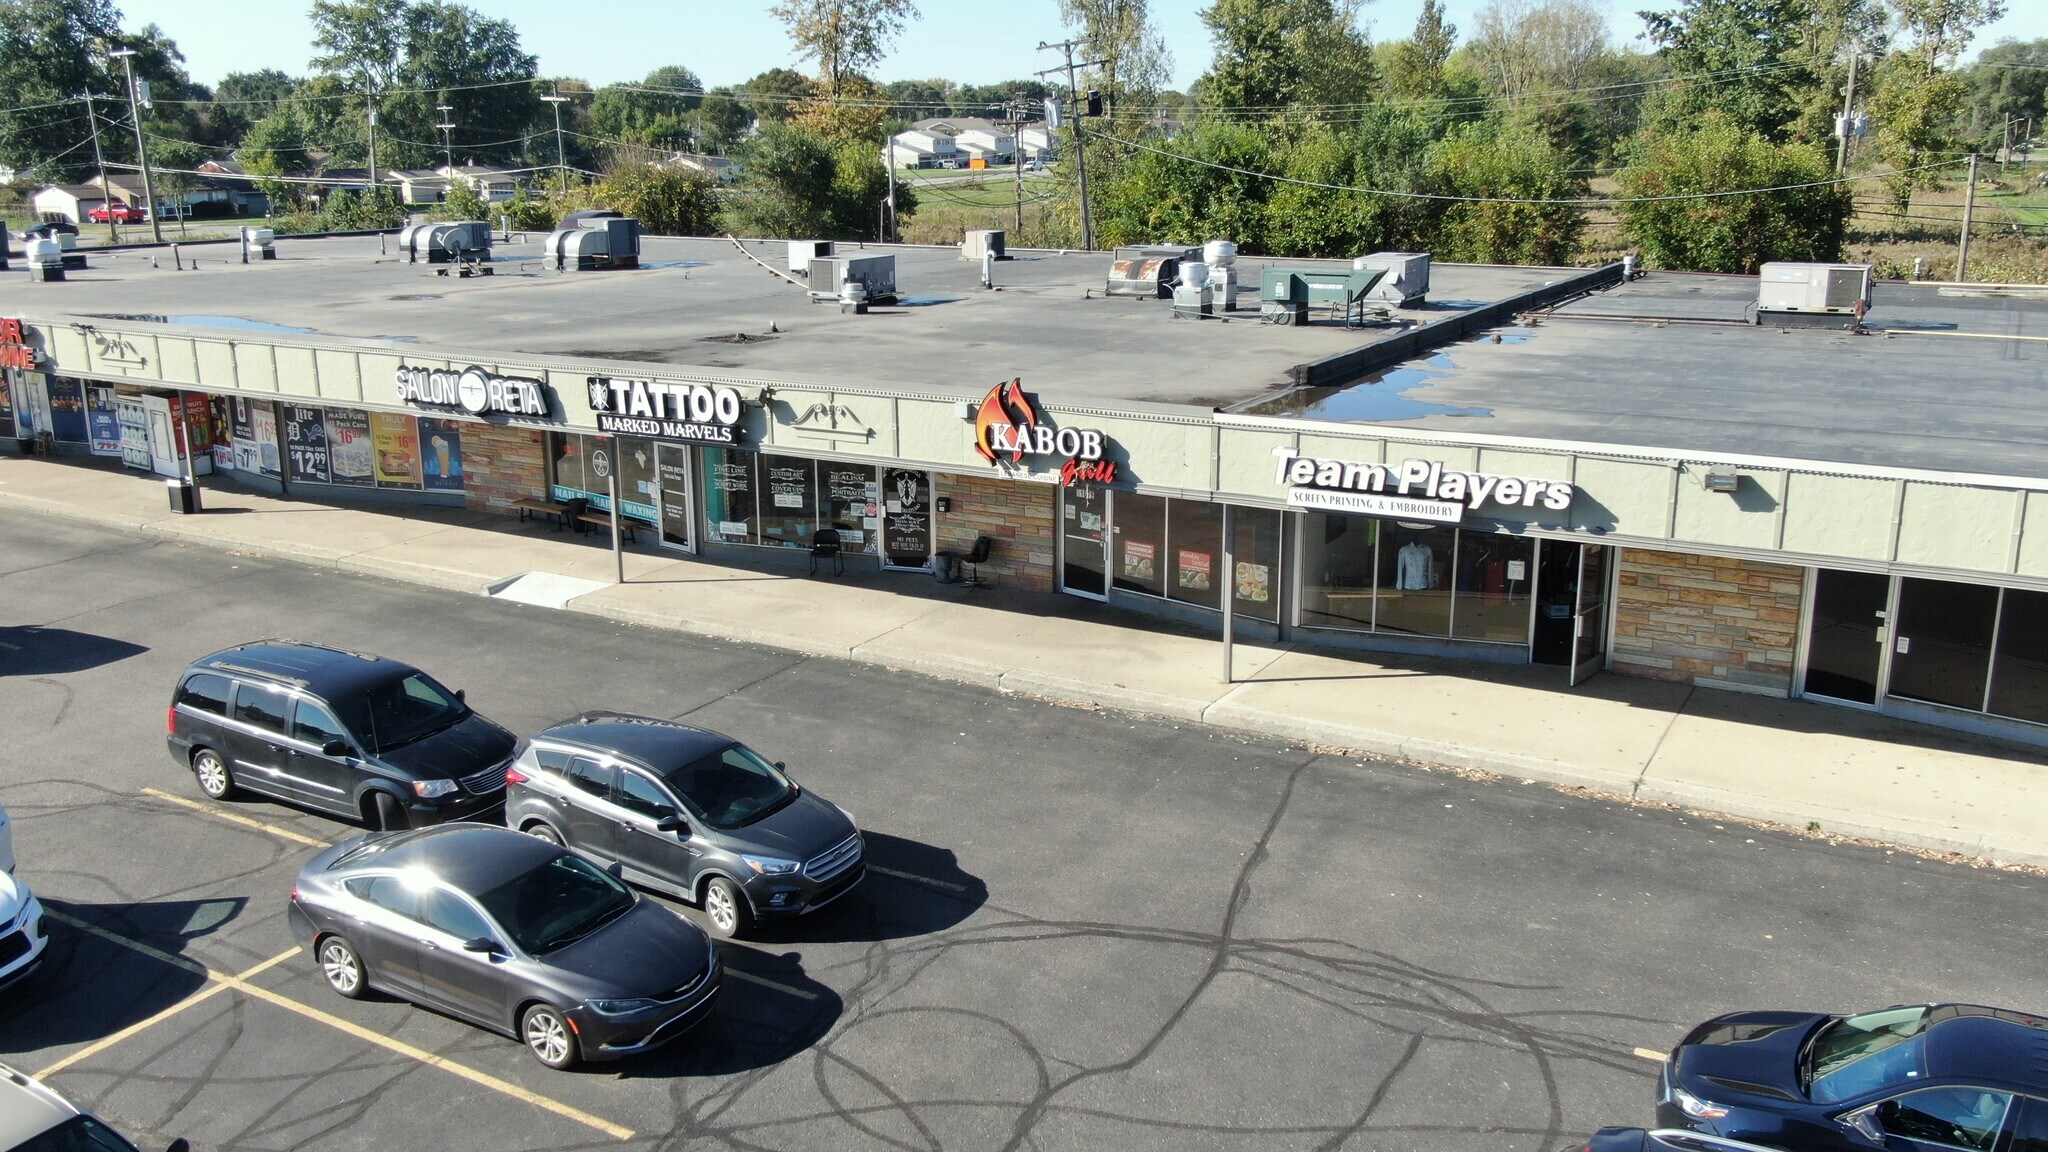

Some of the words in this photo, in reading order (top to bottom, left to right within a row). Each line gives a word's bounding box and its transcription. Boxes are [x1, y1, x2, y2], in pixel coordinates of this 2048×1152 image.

[395, 369, 460, 405] SALON
[489, 379, 546, 415] RETA
[609, 379, 740, 425] TATTOO
[294, 408, 314, 423] Lite
[328, 412, 348, 420] MADE
[349, 413, 367, 421] PURE
[381, 414, 406, 424] TRULY
[601, 416, 660, 435] MARKED
[663, 422, 732, 442] MARVELS
[991, 422, 1102, 460] KABOB
[770, 470, 792, 478] CUSTOM
[1033, 472, 1058, 483] CUISINE
[1271, 446, 1388, 492] Team
[1398, 458, 1573, 510] Players
[554, 487, 584, 500] NAILS
[831, 488, 866, 496] PORTRAITS
[593, 496, 612, 510] HAI
[1294, 491, 1327, 504] SCREEN
[1329, 495, 1373, 509] PRINTING
[1378, 500, 1385, 510] &
[1390, 501, 1453, 517] EMBROIDERY
[624, 503, 658, 519] WAXING
[1127, 544, 1153, 554] SANDWICH
